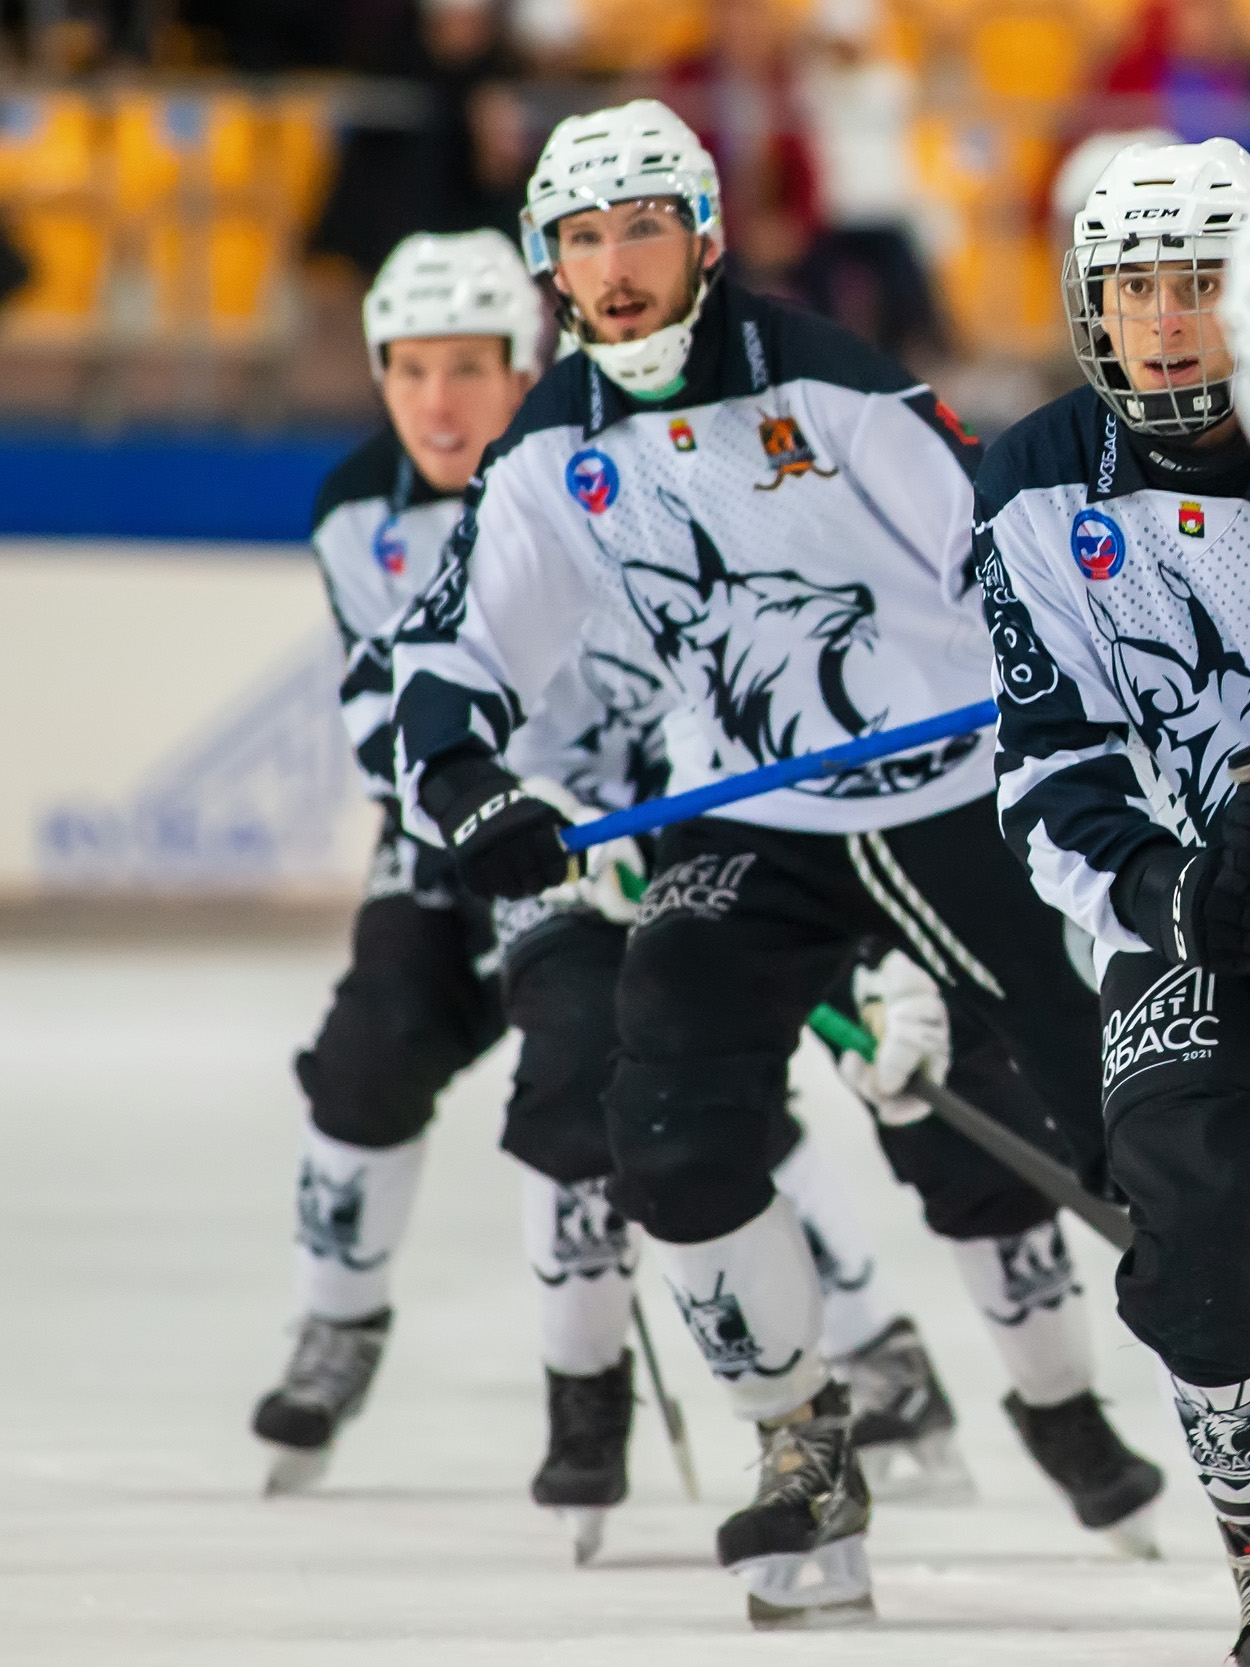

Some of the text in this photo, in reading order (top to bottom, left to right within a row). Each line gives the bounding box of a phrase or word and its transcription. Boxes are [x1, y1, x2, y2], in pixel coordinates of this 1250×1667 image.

[1123, 207, 1181, 221] CCM
[1096, 412, 1118, 494] КУЗБАСС
[1103, 1015, 1220, 1088] ЗБАСС
[1182, 1049, 1212, 1062] 2021
